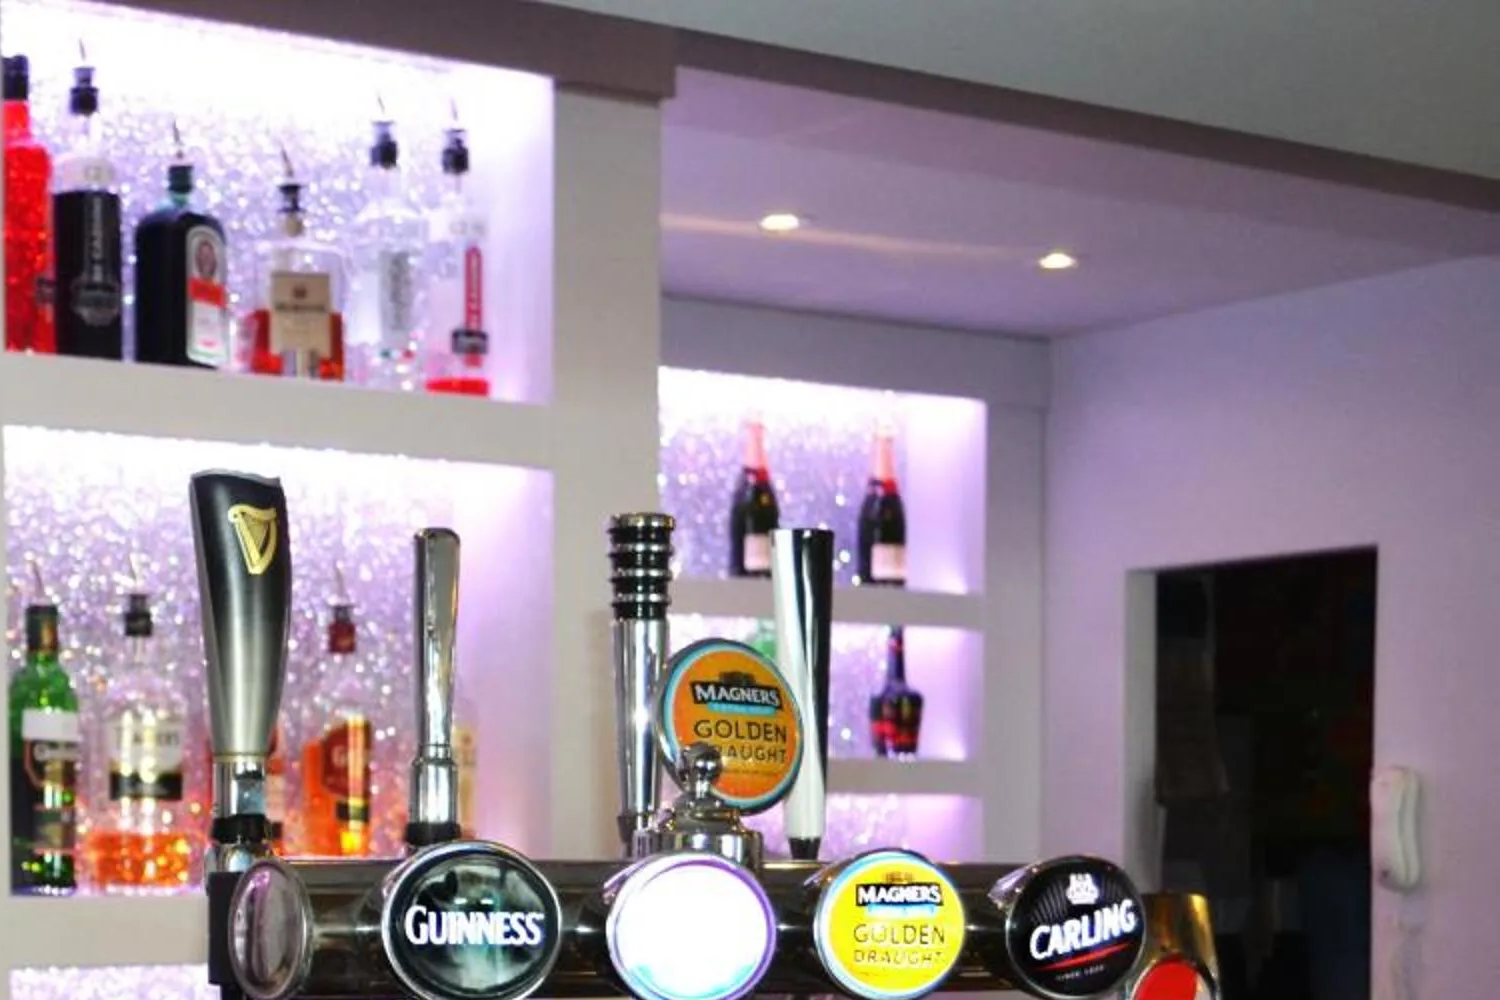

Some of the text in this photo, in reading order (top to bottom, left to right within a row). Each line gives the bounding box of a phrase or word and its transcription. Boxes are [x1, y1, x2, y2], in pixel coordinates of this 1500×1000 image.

[695, 683, 781, 707] MAGNERS
[693, 718, 788, 744] GOLDEN
[717, 744, 787, 765] AUGHT
[857, 884, 942, 904] MAGNERS
[404, 904, 545, 946] GUINNESS
[852, 922, 946, 946] GOLDEN
[1029, 898, 1137, 960] CARLING
[852, 949, 943, 966] DRAUGHT
